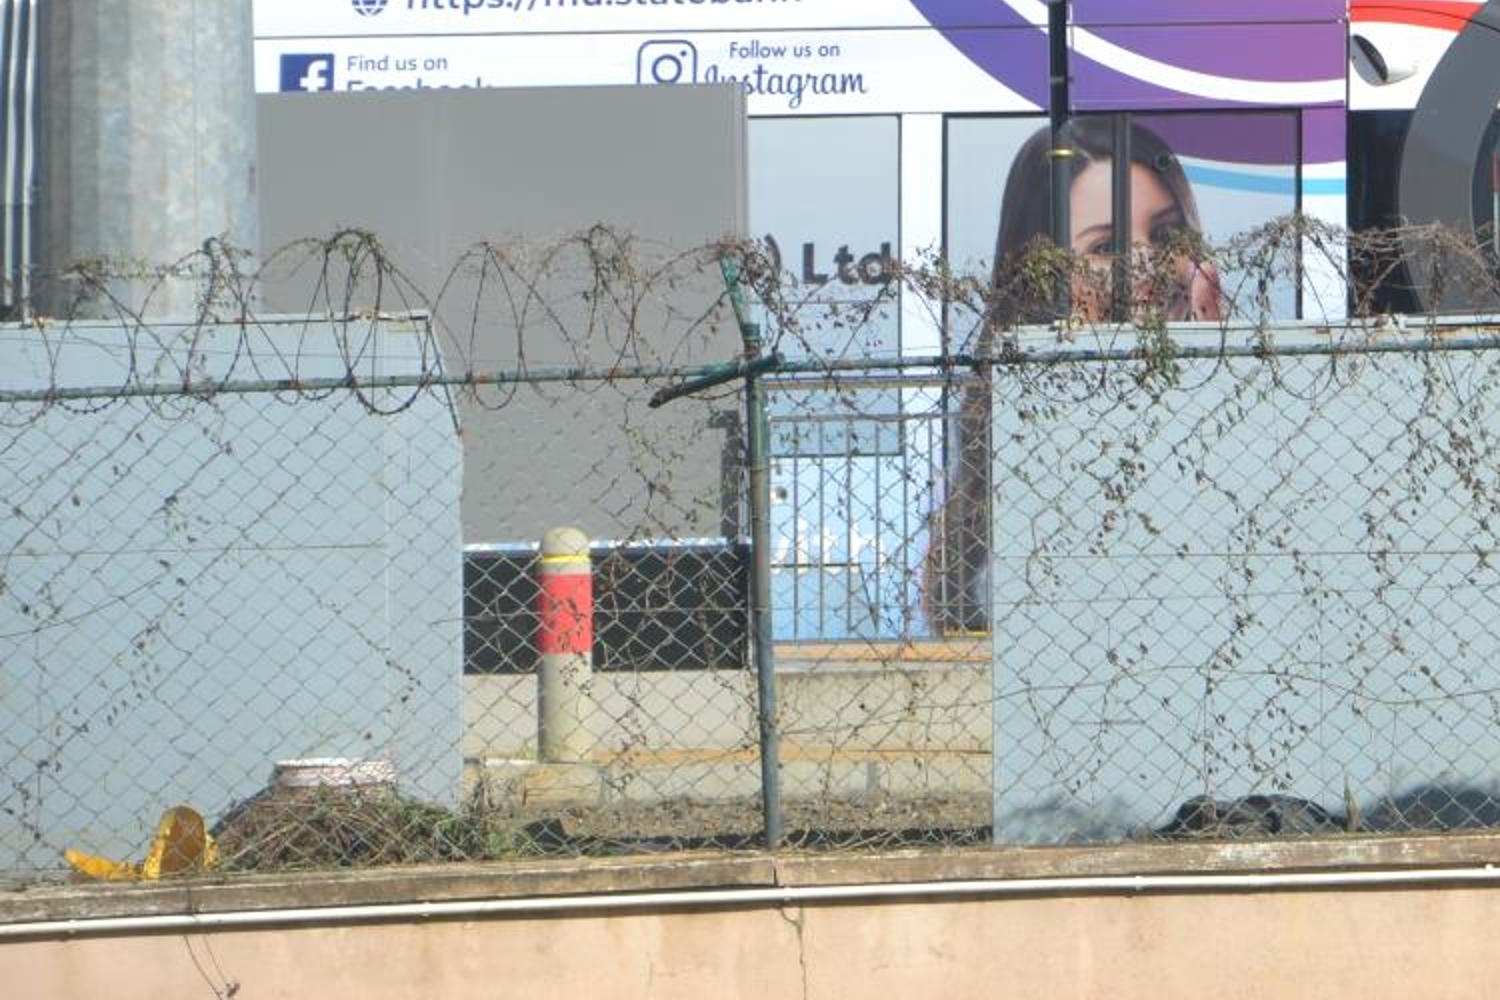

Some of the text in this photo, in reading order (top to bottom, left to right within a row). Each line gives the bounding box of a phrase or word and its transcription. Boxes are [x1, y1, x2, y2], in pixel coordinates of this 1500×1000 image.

[729, 40, 840, 59] Follow us on
[347, 55, 447, 72] Find us on
[803, 242, 892, 285] Ltd
